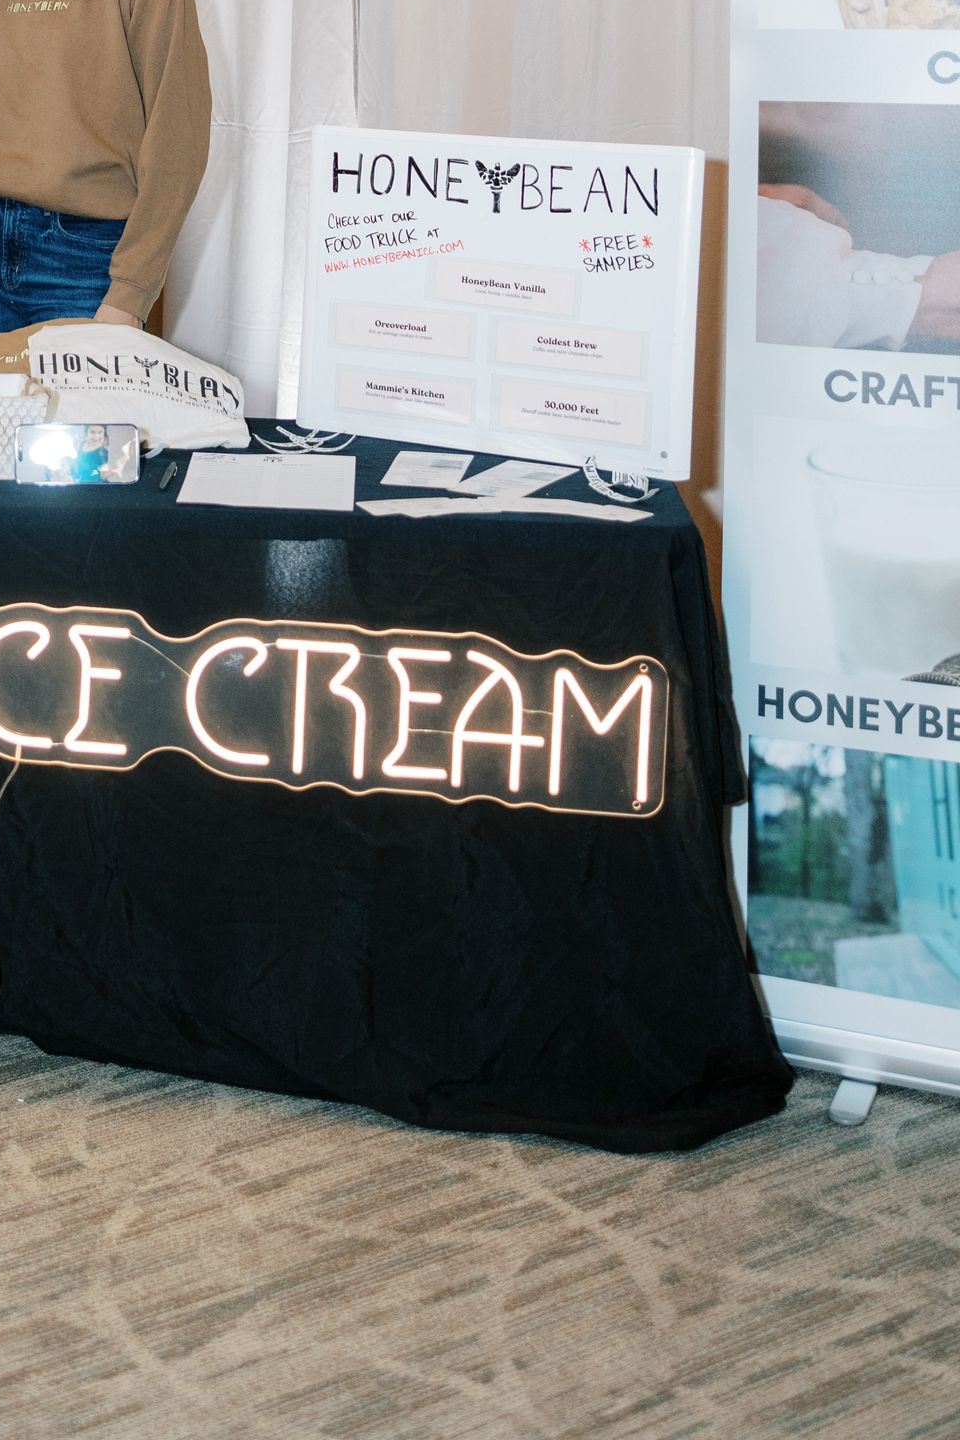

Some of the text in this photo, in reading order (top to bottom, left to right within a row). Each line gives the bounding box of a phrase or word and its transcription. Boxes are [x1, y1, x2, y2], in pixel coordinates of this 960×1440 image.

[7, 1, 70, 13] HONEYBEAN
[333, 151, 658, 216] HONEYBEAN
[328, 210, 418, 229] CHECK OUT OUR
[324, 227, 440, 253] FOOD TRUCK AT
[583, 253, 655, 273] SAMPLES
[461, 275, 546, 294] HoneyBean Vanilla
[374, 319, 427, 332] Oreoverload
[536, 335, 598, 350] Coldest Brew
[365, 381, 409, 394] Mammie's
[411, 387, 445, 399] Kitchen
[544, 400, 600, 415] 30,000 Feet
[185, 635, 653, 805] CREAM
[758, 683, 960, 742] HONEYBE
